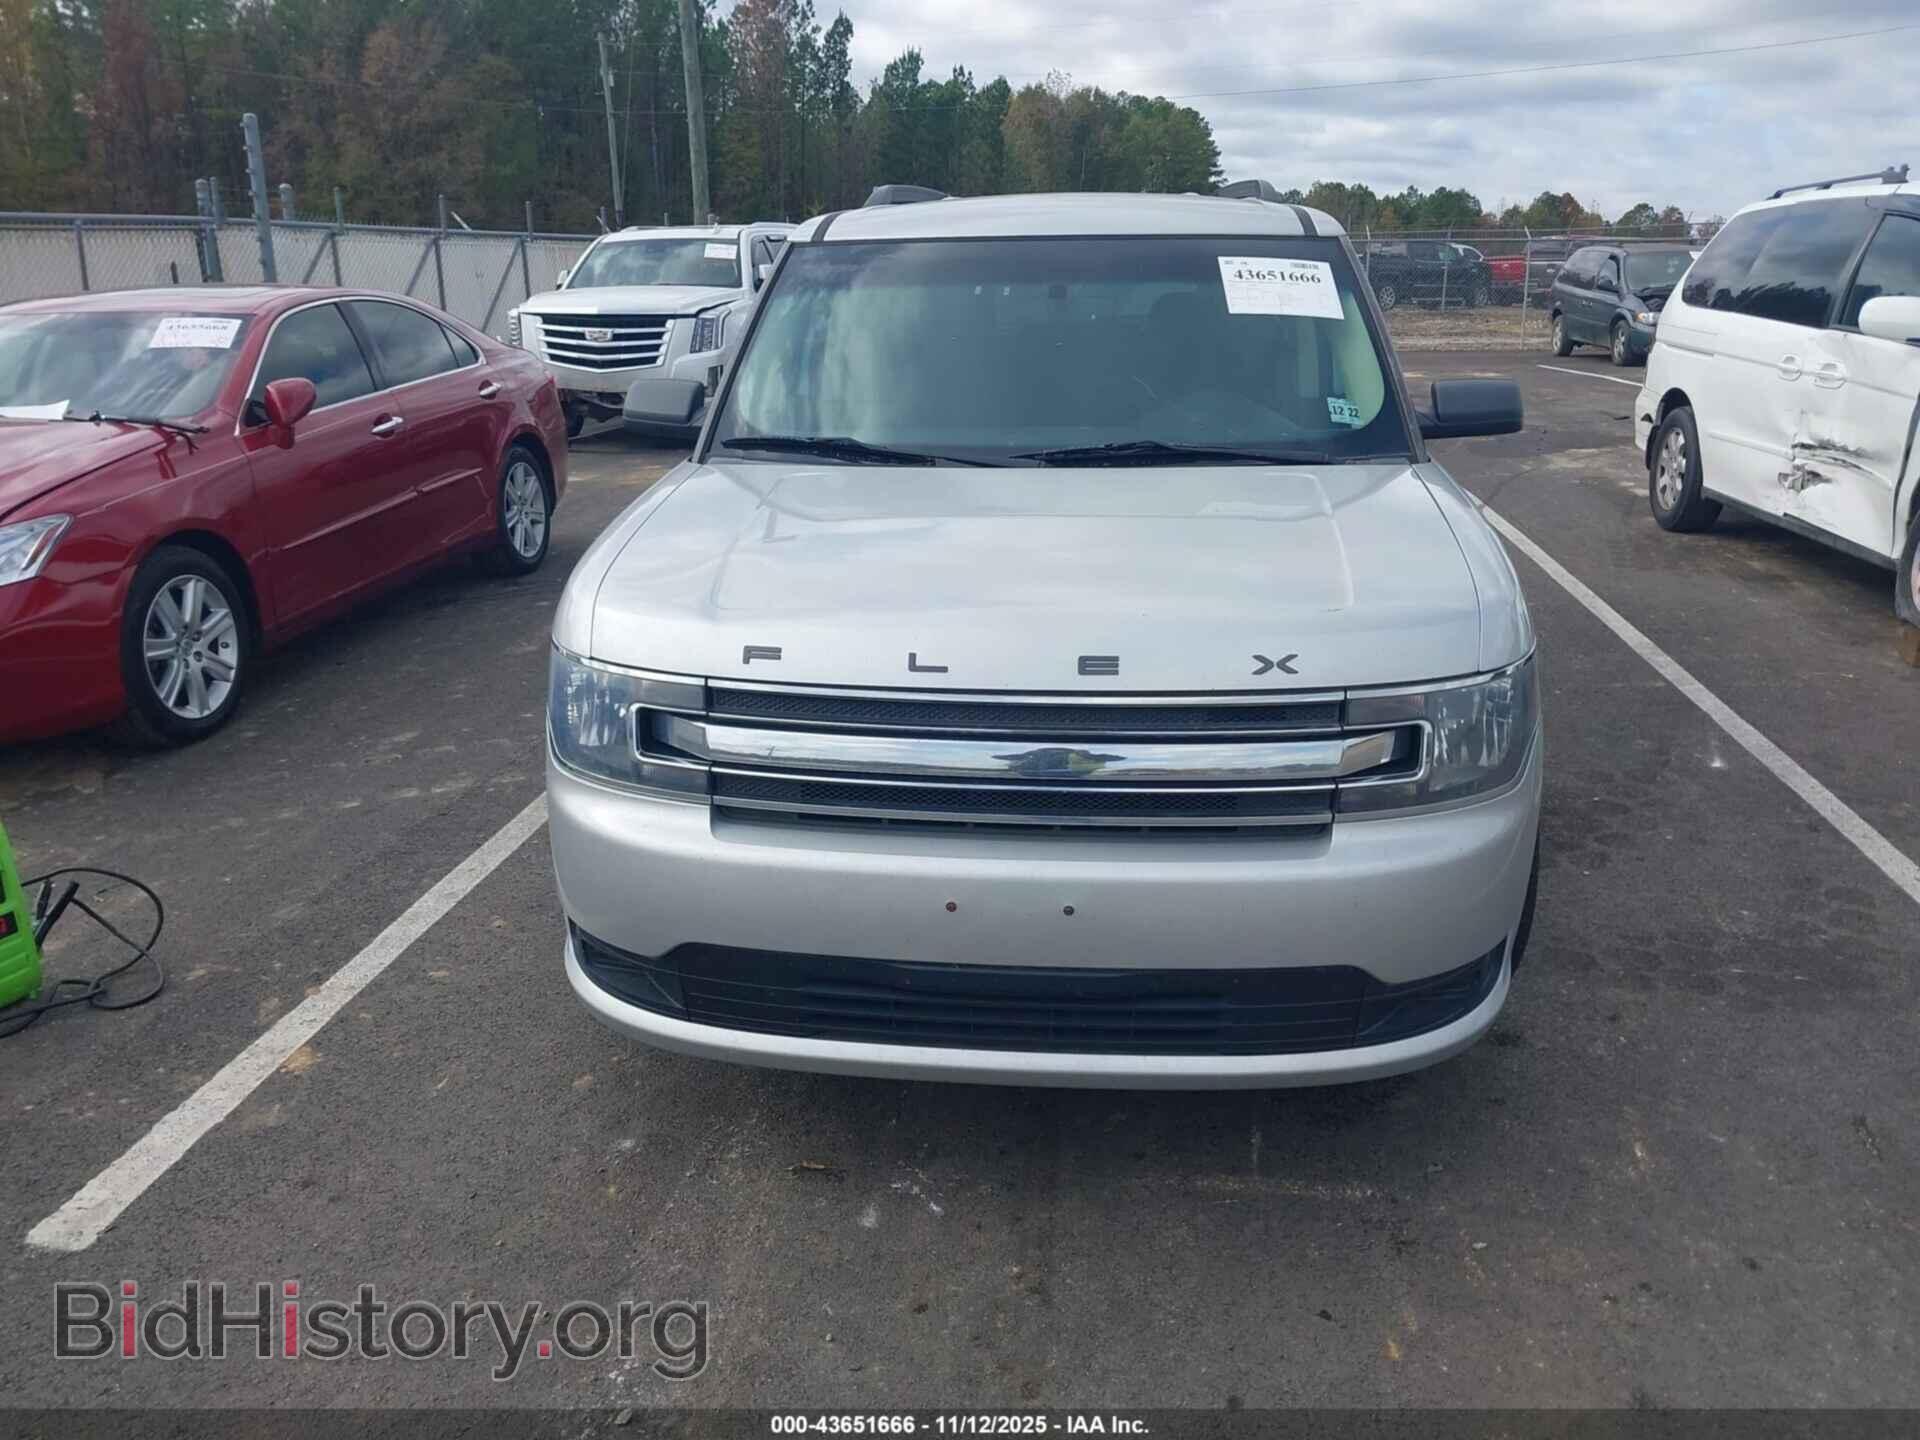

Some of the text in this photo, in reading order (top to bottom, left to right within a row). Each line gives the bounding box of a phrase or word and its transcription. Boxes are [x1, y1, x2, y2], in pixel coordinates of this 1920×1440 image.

[1233, 268, 1321, 284] 43651666
[1347, 407, 1360, 418] 22
[742, 645, 1298, 676] FLEX
